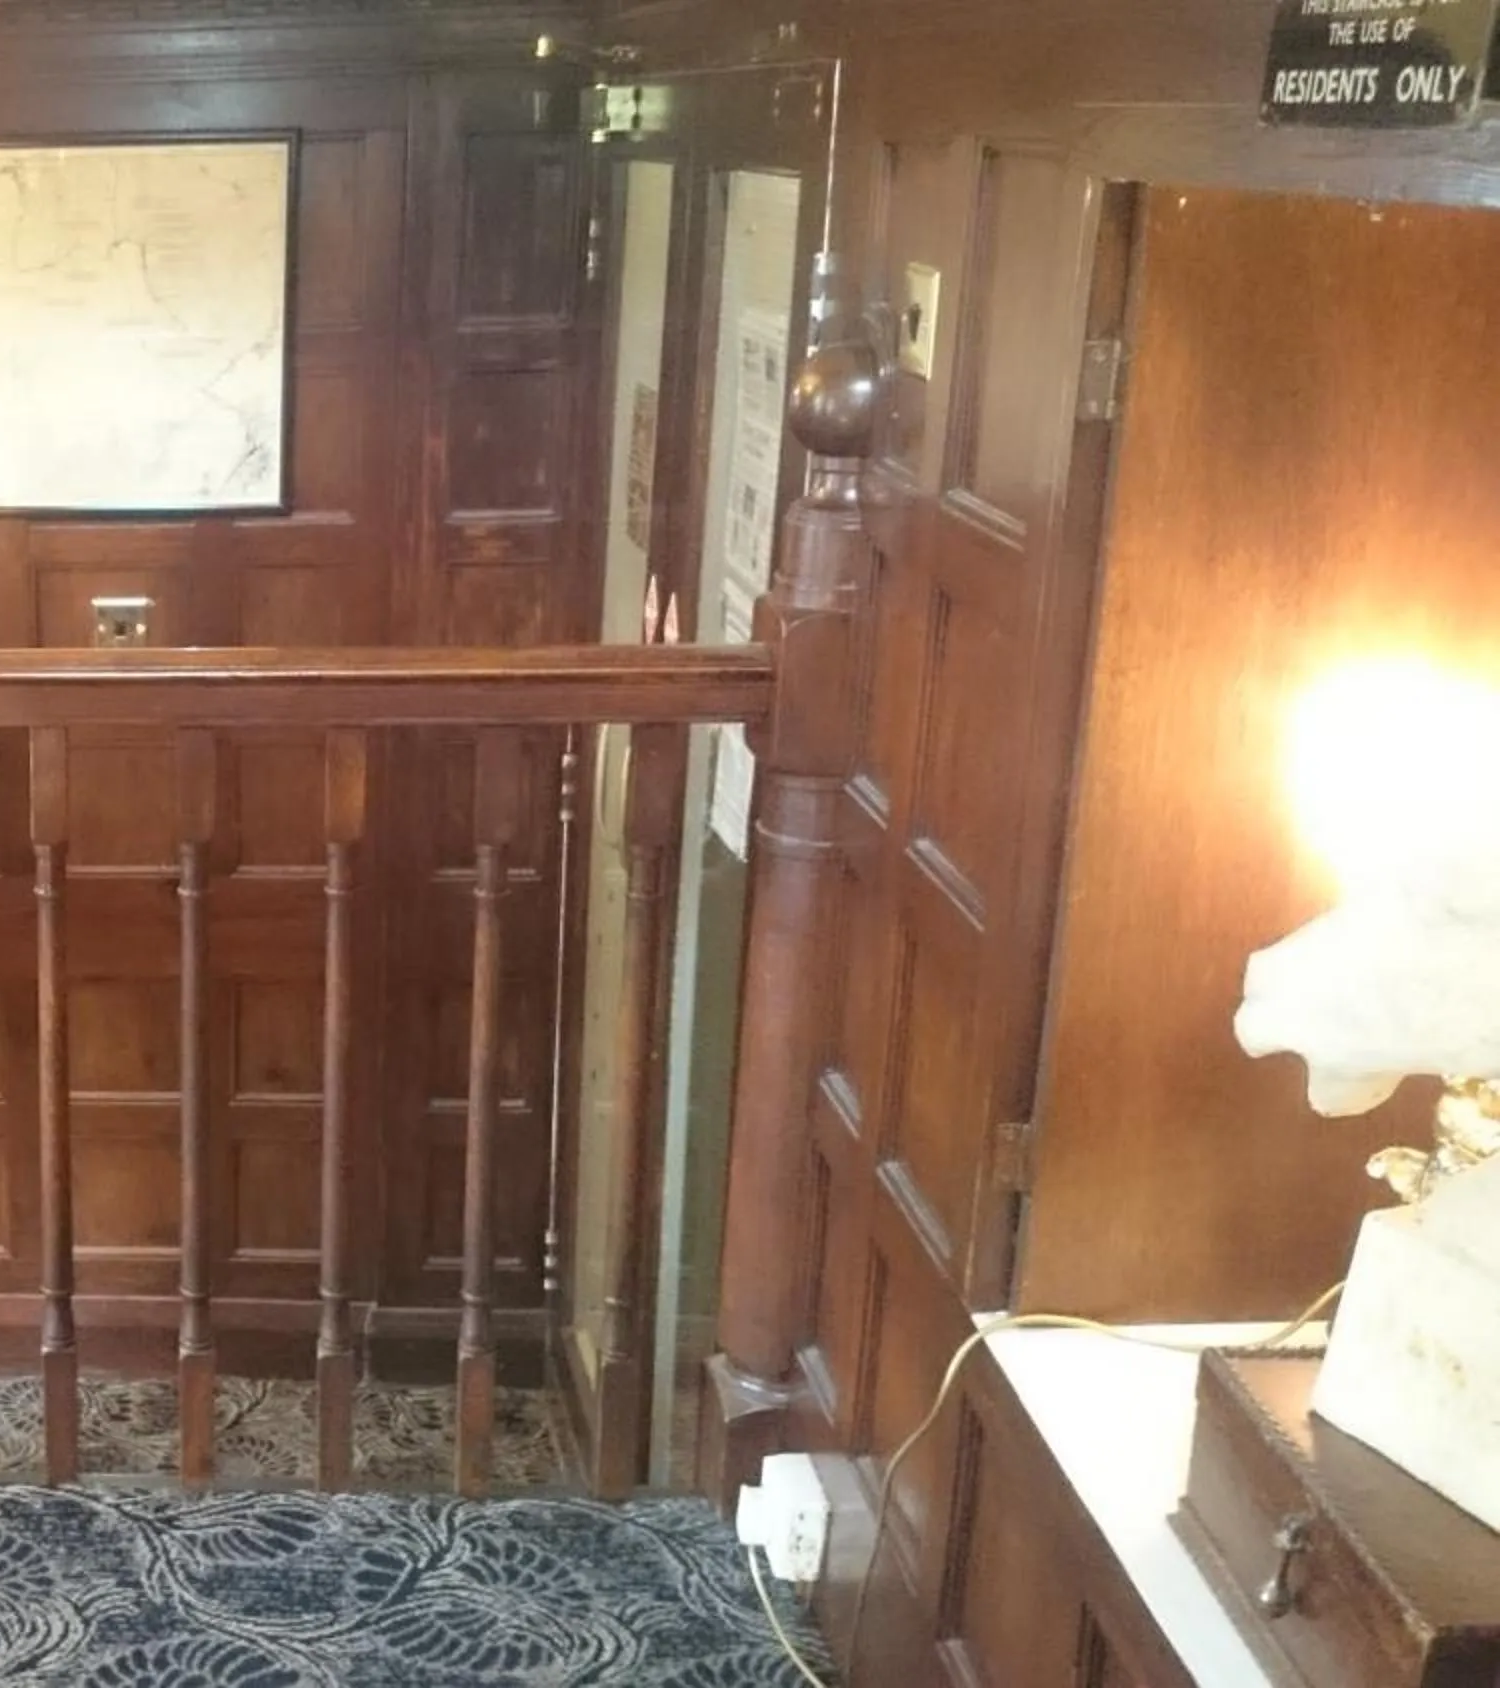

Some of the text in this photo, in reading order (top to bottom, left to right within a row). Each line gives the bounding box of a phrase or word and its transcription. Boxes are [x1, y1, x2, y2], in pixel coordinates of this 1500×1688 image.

[1329, 16, 1416, 45] THE USE OF
[1273, 64, 1466, 103] RESIDENTS ONLY
